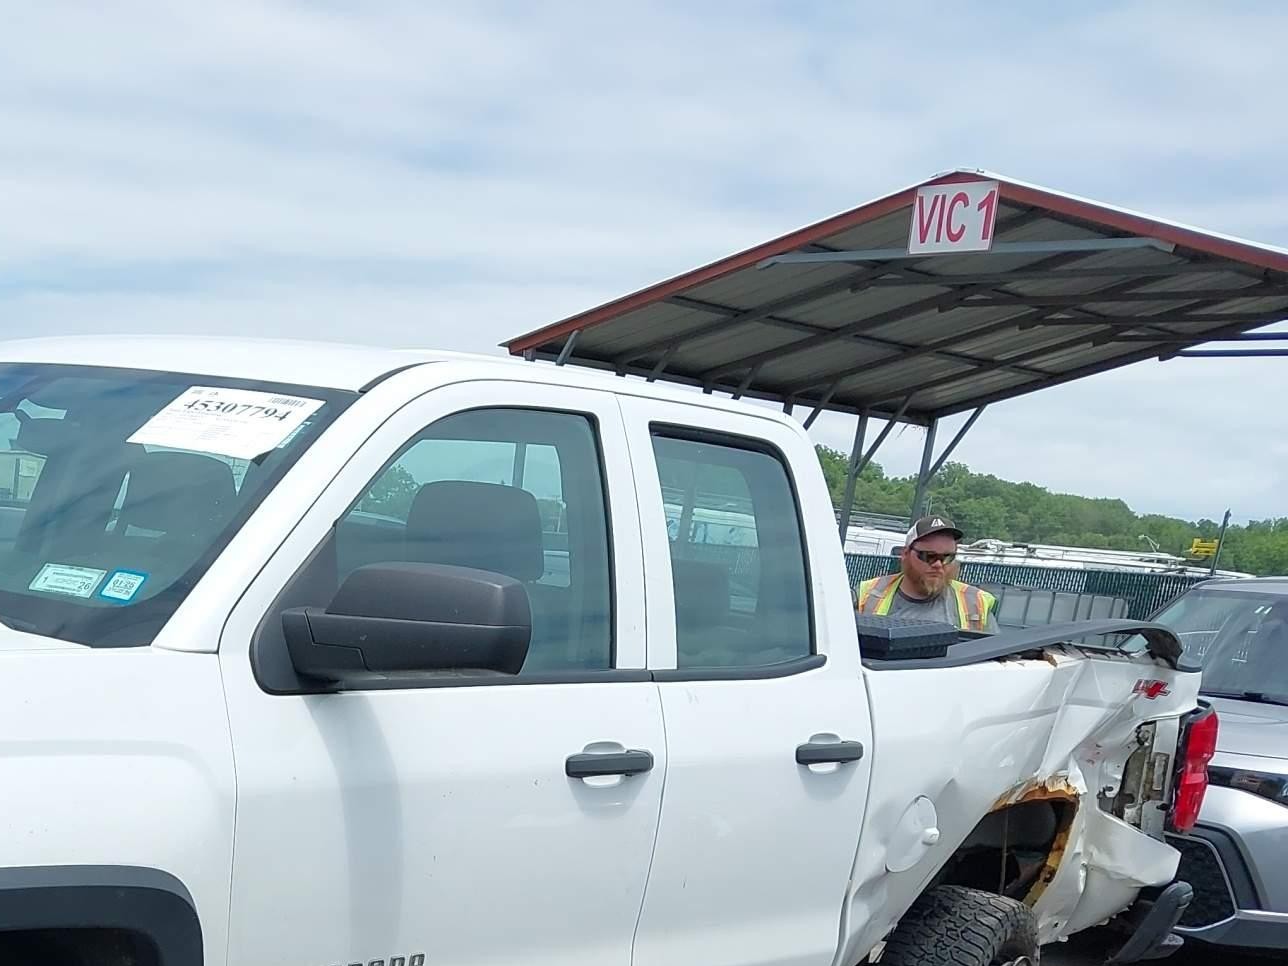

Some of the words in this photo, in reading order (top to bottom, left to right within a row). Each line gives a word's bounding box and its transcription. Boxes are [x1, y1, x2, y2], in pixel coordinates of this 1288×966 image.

[918, 192, 969, 244] VIC
[978, 190, 995, 240] 1
[185, 398, 291, 421] 45307794
